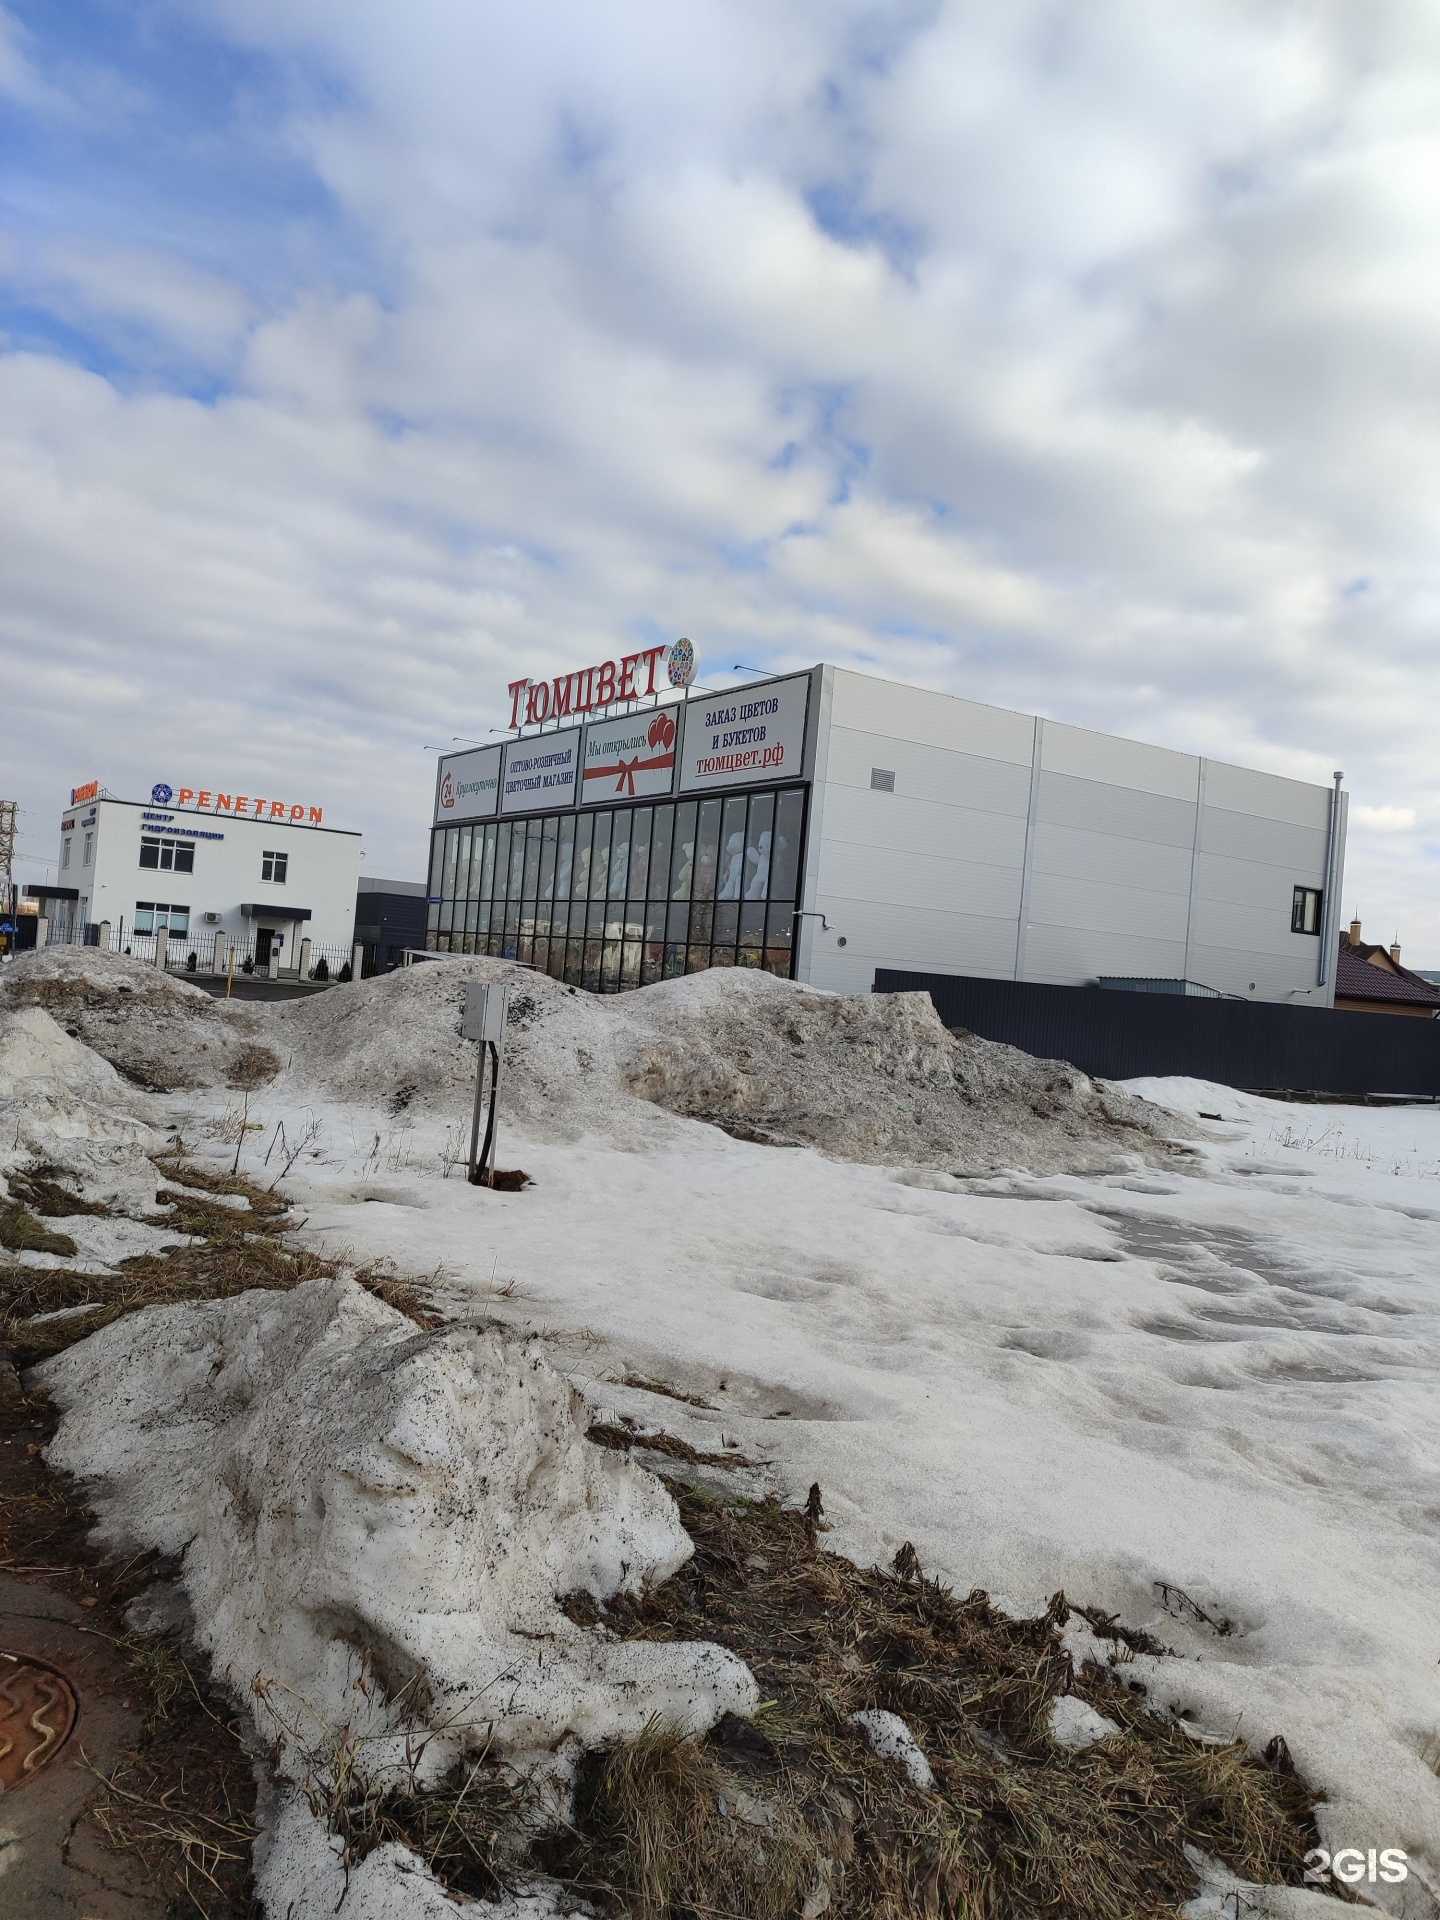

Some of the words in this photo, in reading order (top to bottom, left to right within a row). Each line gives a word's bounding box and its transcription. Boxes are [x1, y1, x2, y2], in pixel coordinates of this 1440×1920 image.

[705, 707, 737, 727] ЗАКАЗ
[739, 697, 779, 722] ЦВЕТОВ
[587, 740, 602, 757] Мы
[602, 735, 647, 757] открылись
[711, 735, 720, 750] И
[722, 726, 758, 748] БУКЕТОВ
[505, 775, 542, 797] ЦВЕТОЧНЫЙ
[542, 770, 574, 789] МАГАЗИН
[143, 812, 175, 823] ЦЕНТР
[179, 788, 323, 823] PENETRON
[141, 823, 225, 841] ГИДРОИЗОЛЯЦИИ
